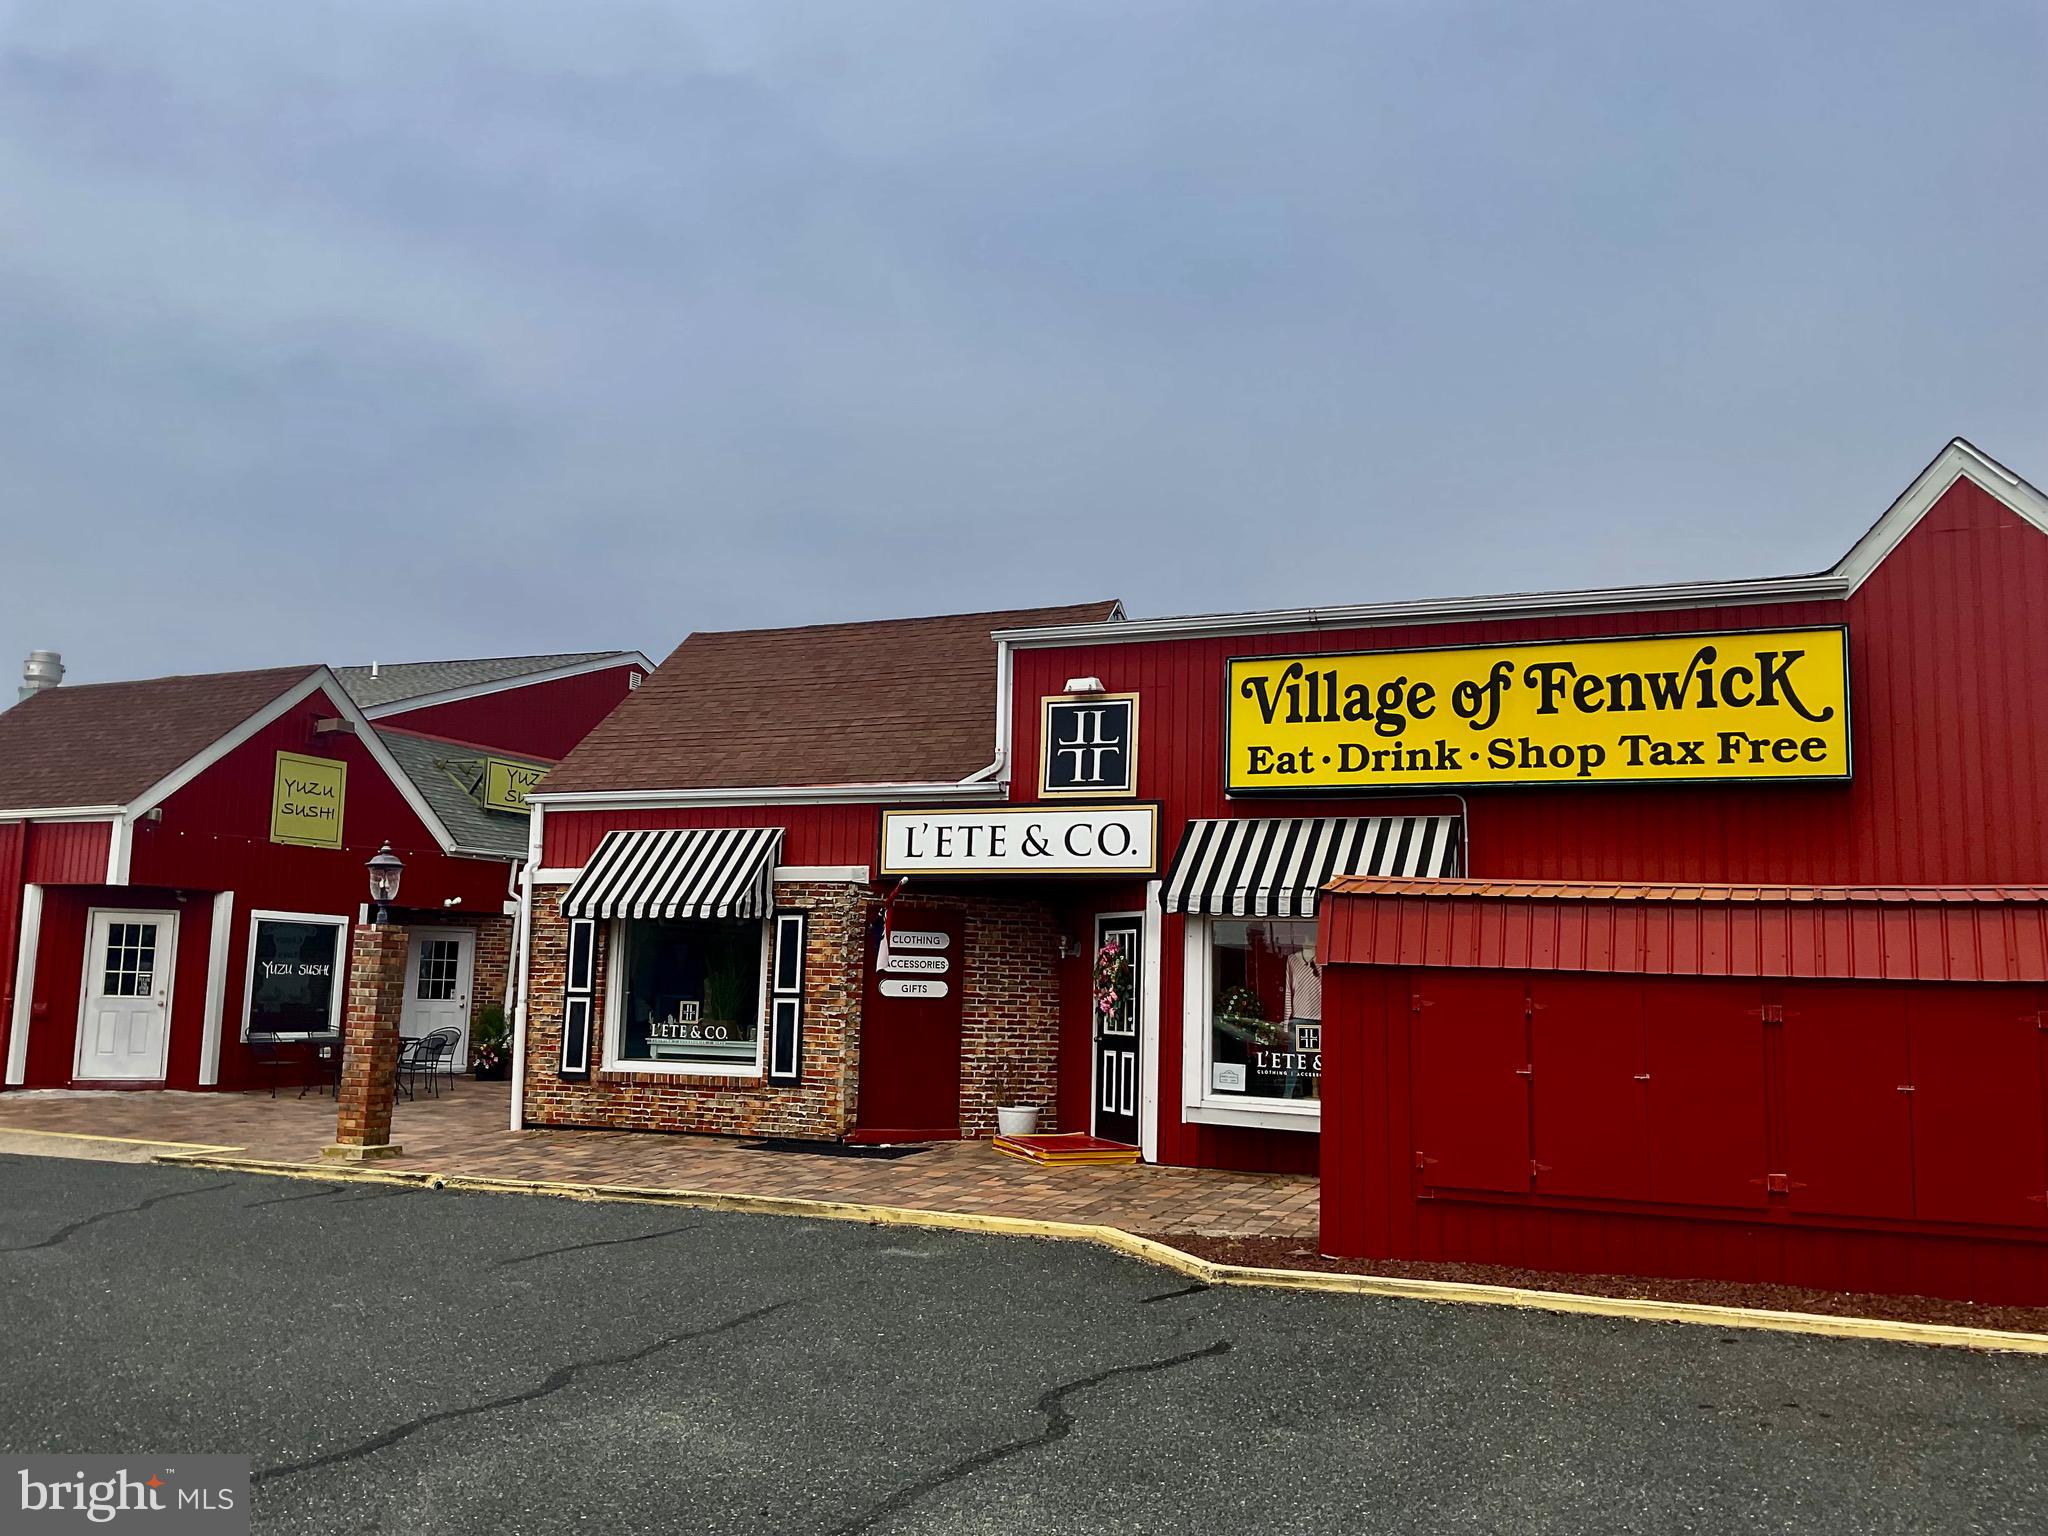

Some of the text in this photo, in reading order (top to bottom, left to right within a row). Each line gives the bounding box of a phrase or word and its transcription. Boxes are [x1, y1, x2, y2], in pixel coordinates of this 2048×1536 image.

[1241, 662, 1436, 737] Village
[1451, 660, 1512, 731] of
[1247, 731, 1827, 776] Eat Drink Shop Tax Free
[284, 778, 334, 798] YUZU
[507, 768, 540, 790] YUZ
[281, 803, 335, 820] SUSHI
[904, 822, 1138, 858] L'ETE & CO.
[892, 935, 940, 945] CLOTHING
[298, 964, 329, 977] SUSHI
[901, 984, 928, 993] GIFTS
[651, 1023, 728, 1040] L'ETE & CO.
[1256, 1051, 1306, 1069] L'ETE
